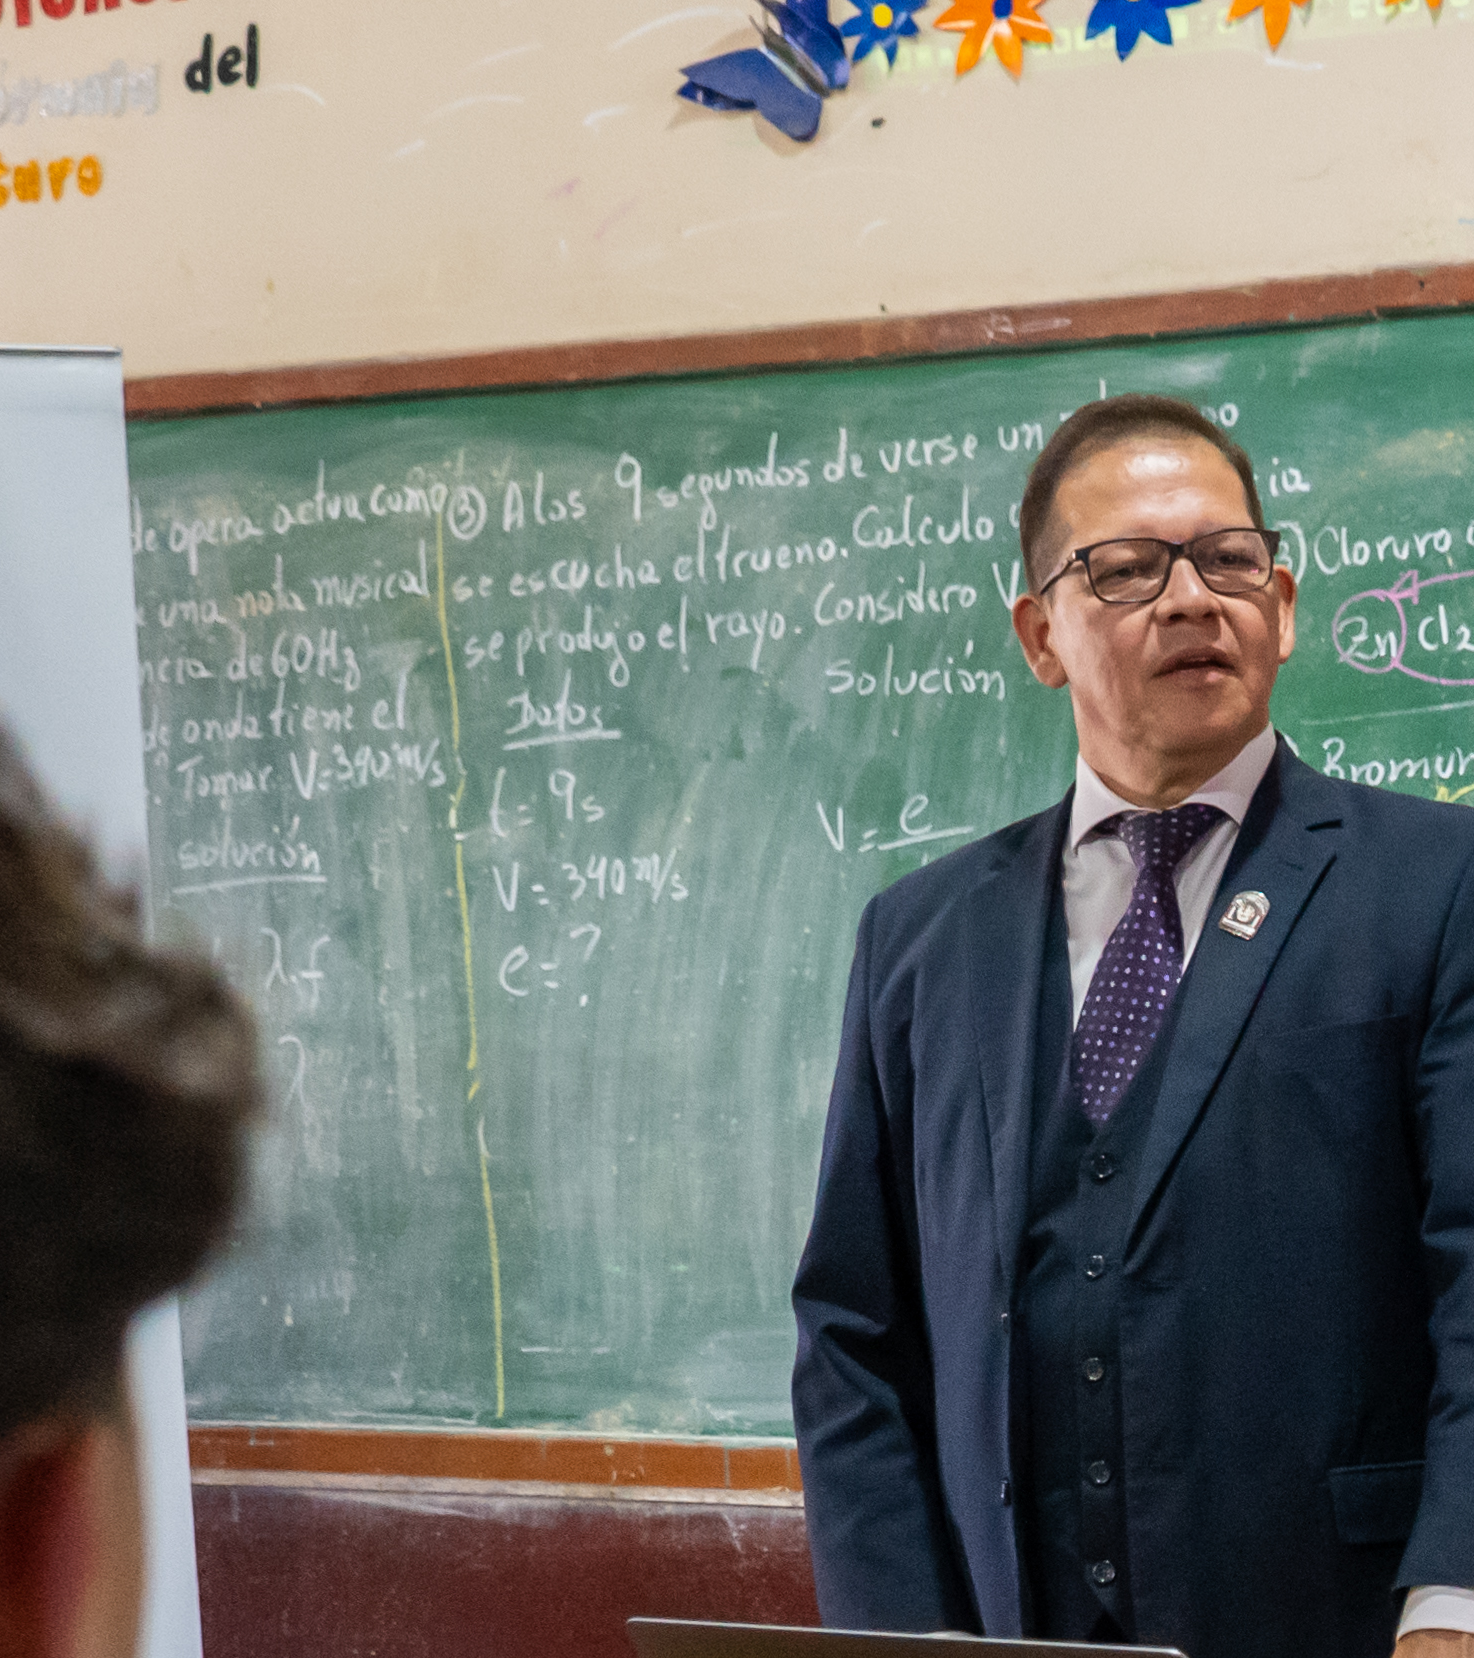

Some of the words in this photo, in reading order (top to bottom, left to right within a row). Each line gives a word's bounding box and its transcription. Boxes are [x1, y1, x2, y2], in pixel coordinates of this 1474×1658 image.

[184, 22, 259, 95] del
[614, 452, 642, 521] 9
[657, 431, 811, 531] segundos
[824, 427, 866, 485] de
[879, 432, 979, 476] verse
[997, 421, 1044, 452] un
[313, 538, 433, 608] musical
[509, 543, 660, 596] escucha
[516, 604, 646, 689] produjo
[657, 594, 690, 673] el
[814, 560, 979, 630] Considero
[182, 690, 264, 744] onda
[372, 667, 408, 731] el
